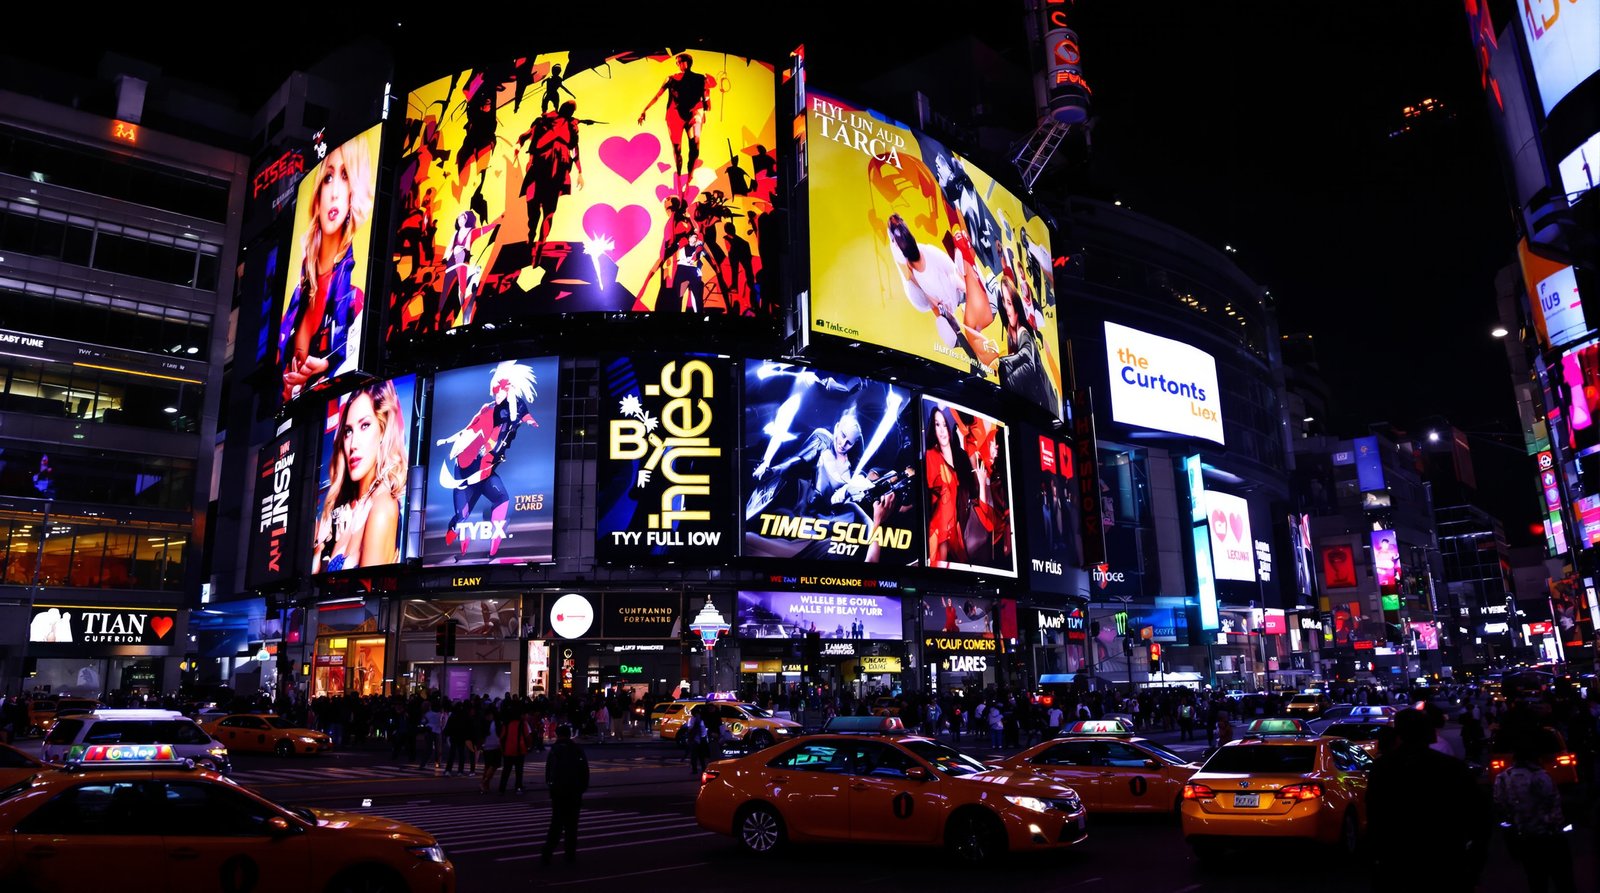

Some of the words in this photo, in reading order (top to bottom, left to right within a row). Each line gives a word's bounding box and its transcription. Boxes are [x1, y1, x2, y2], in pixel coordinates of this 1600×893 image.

[814, 112, 903, 170] TARCA
[1117, 348, 1149, 370] the
[1121, 366, 1206, 401] Curtonts
[760, 513, 830, 540] TIMES
[612, 532, 642, 545] TYY
[647, 532, 684, 546] FULL
[828, 541, 859, 557] 2017
[453, 577, 482, 587] LEANY
[836, 597, 848, 606] BE
[82, 612, 148, 635] TIAN
[949, 655, 987, 672] TARES
